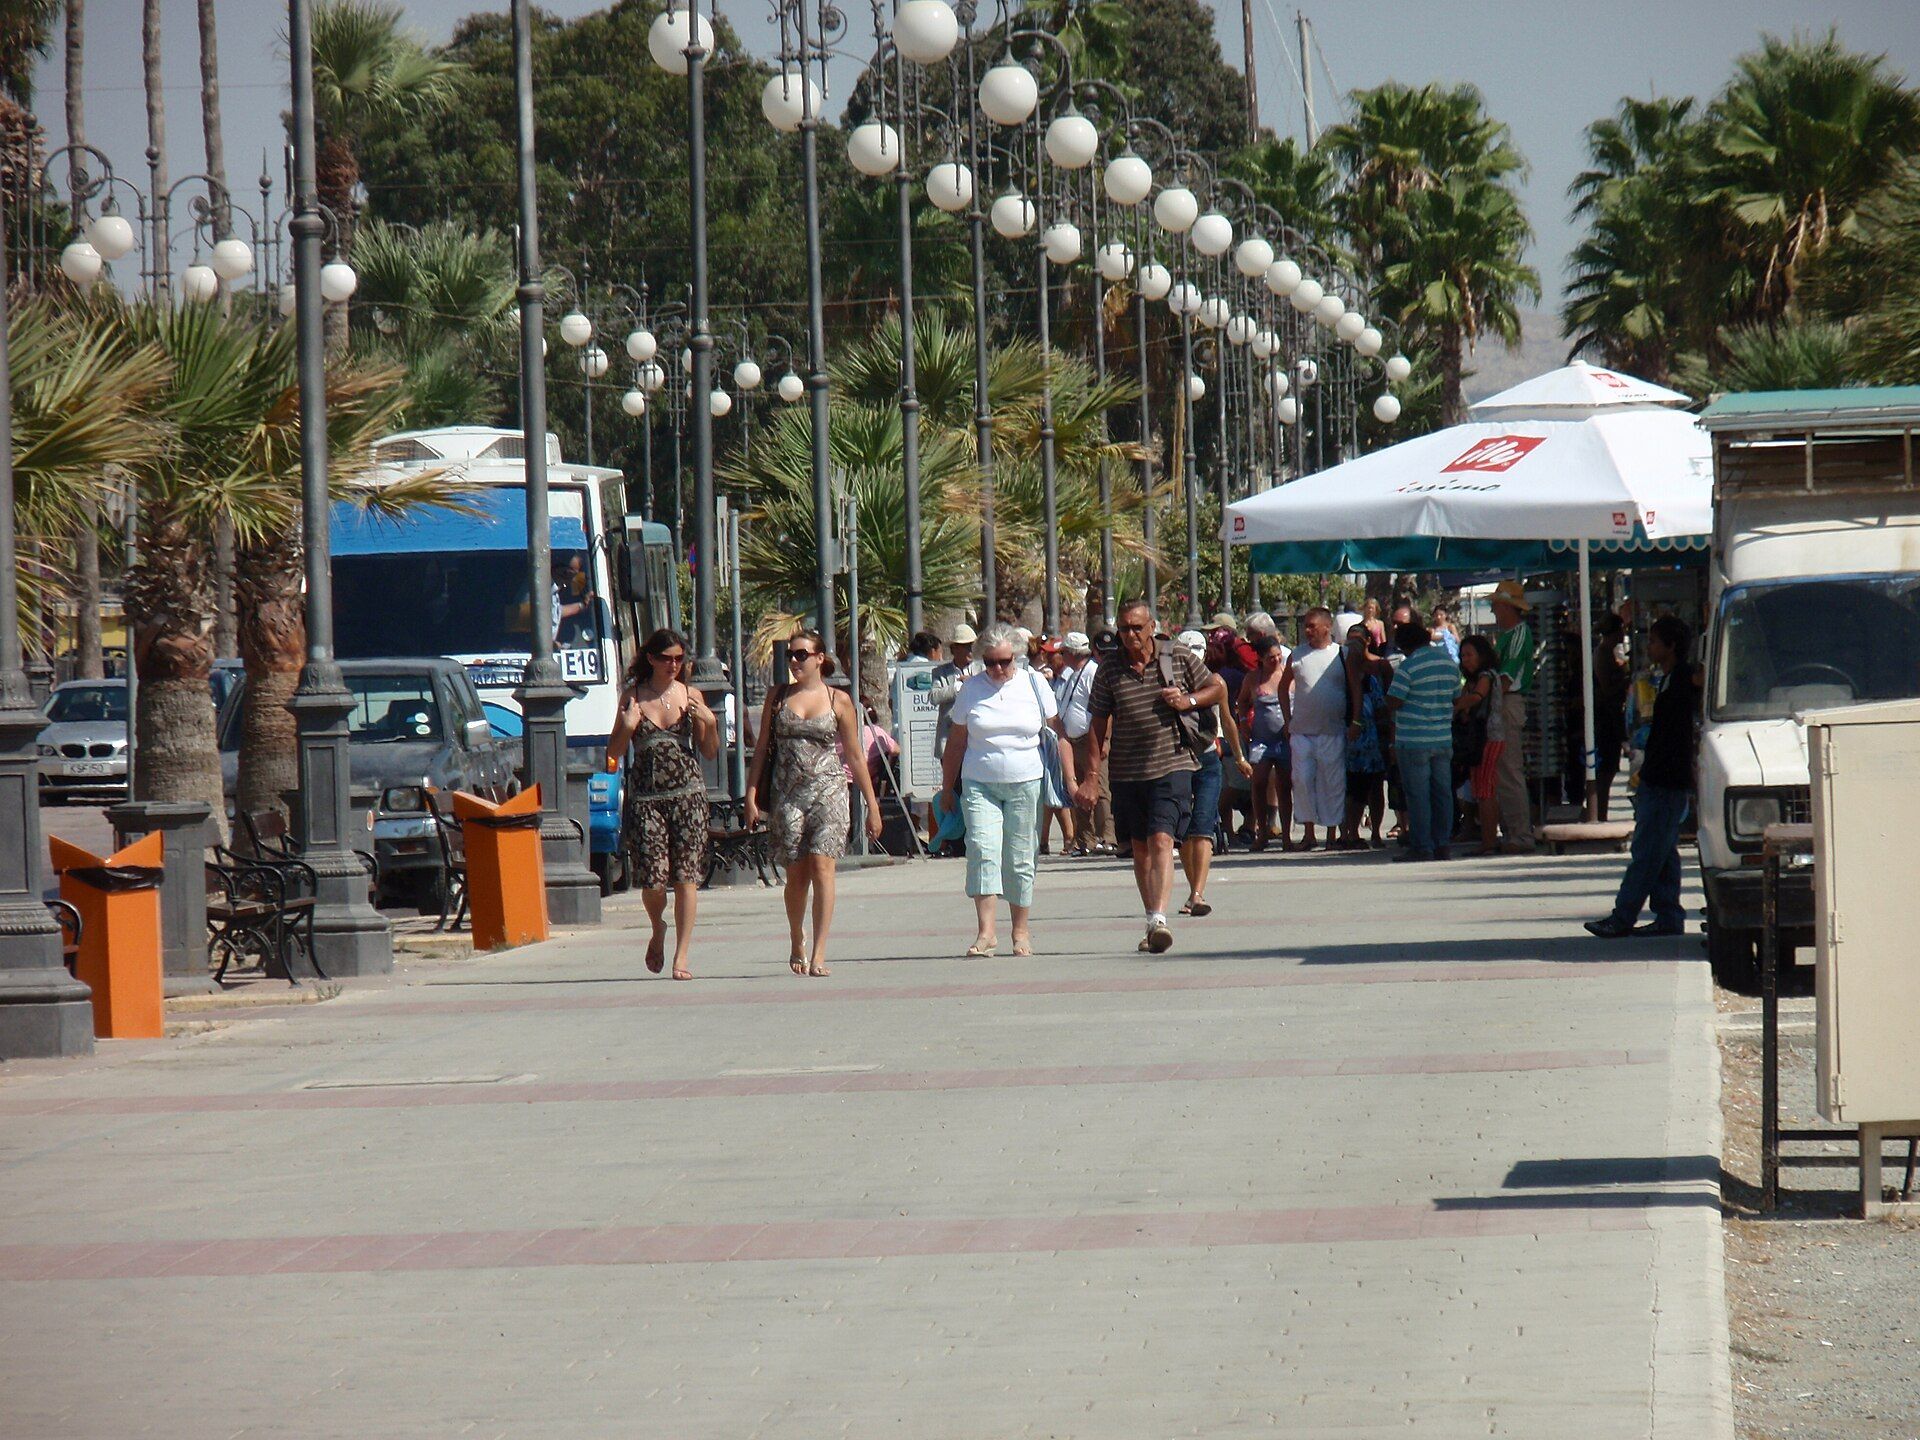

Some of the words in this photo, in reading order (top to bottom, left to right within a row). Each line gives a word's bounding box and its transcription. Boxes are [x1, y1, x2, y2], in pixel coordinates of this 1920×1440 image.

[1455, 439, 1525, 468] illy
[567, 651, 598, 675] E19
[913, 694, 931, 704] BU
